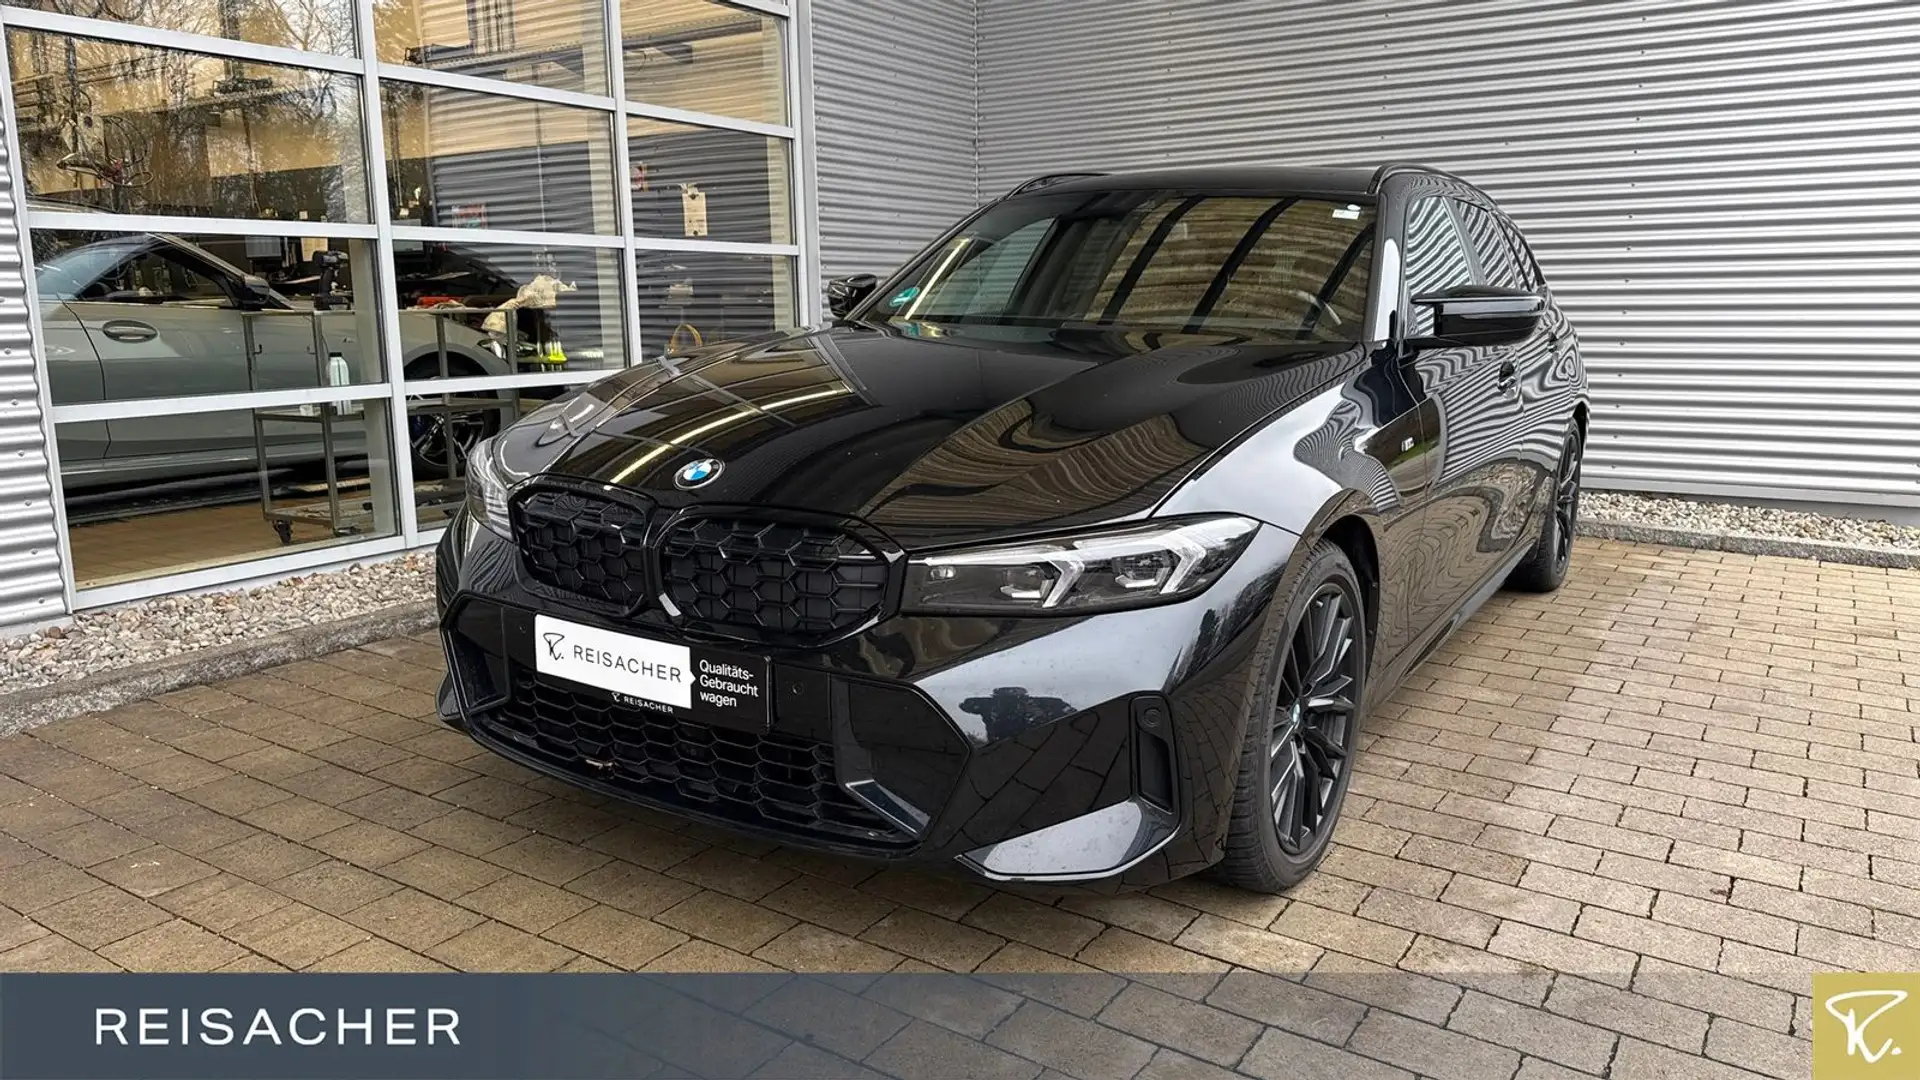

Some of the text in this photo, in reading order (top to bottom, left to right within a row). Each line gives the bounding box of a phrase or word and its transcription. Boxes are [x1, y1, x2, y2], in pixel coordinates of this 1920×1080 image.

[573, 644, 682, 683] REISACHER
[699, 659, 754, 681] Qualitäts-
[699, 674, 759, 697] Gebraucht
[623, 695, 674, 714] REISACHER
[699, 691, 737, 707] wagen
